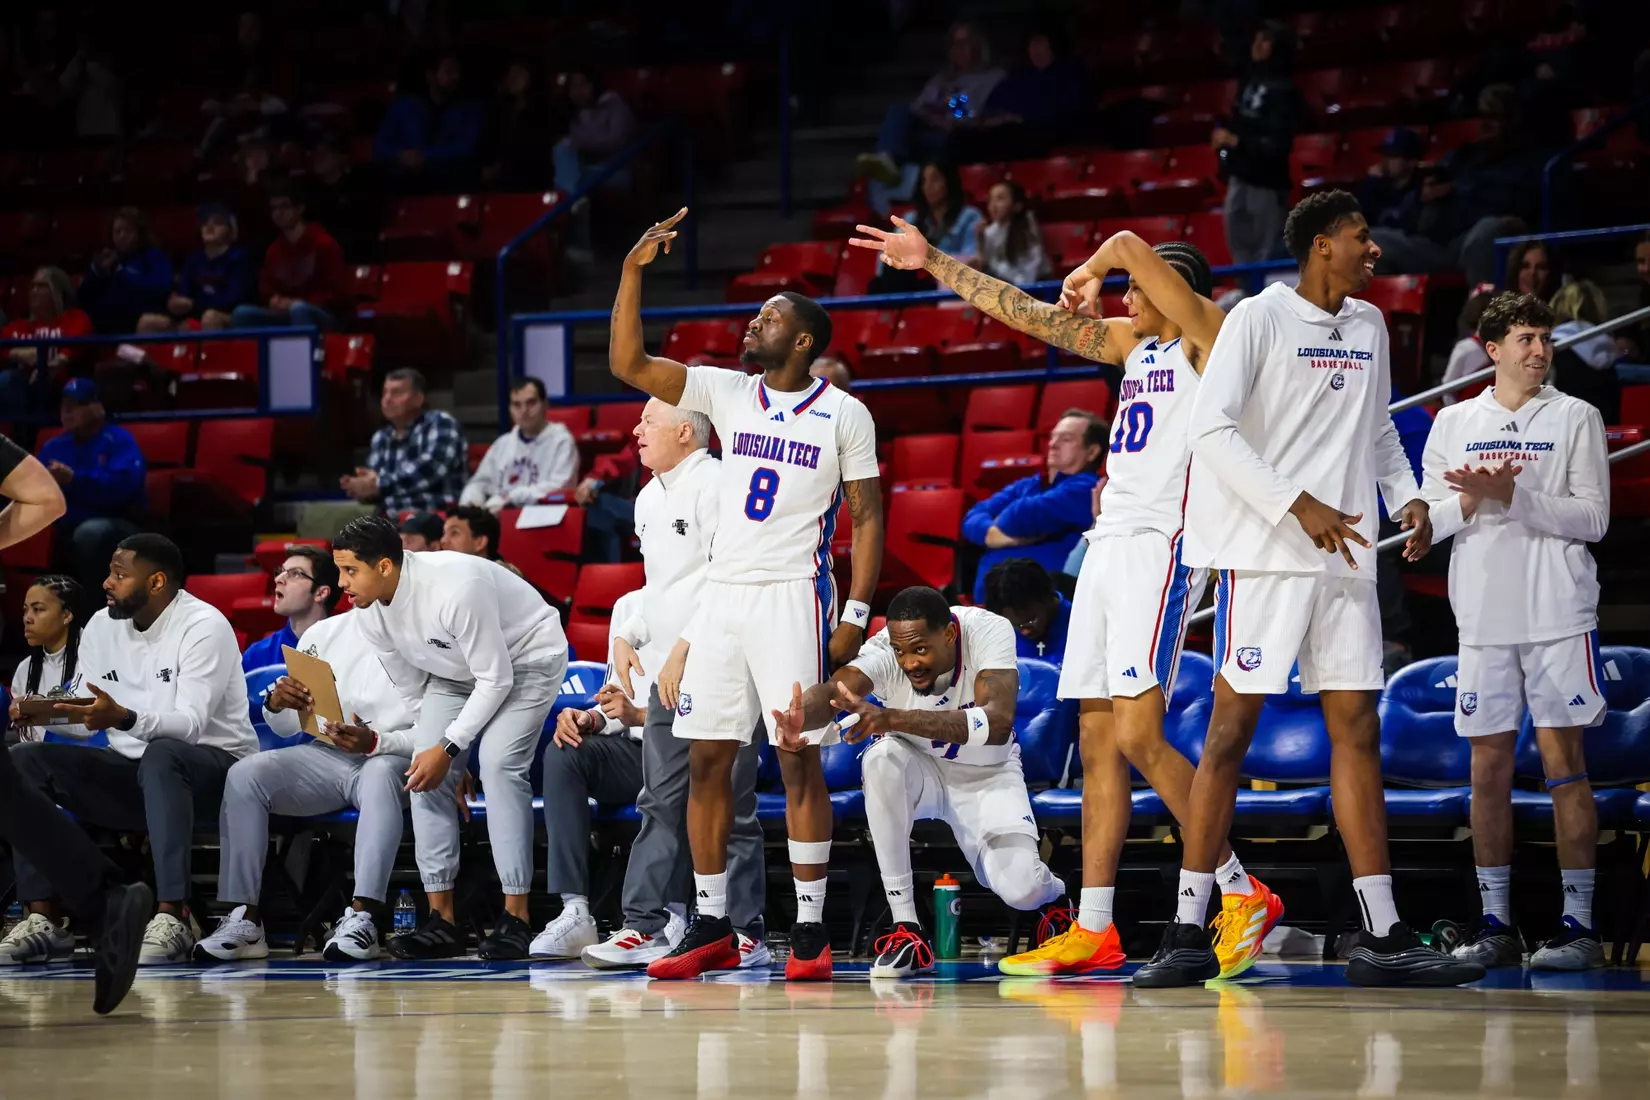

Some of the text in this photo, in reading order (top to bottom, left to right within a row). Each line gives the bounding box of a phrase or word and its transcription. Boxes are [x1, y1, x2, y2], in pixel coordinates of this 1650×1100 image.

[1297, 347, 1373, 361] LOUISIANA TECH
[1310, 360, 1364, 370] BASKETBALL
[1147, 369, 1174, 393] TECH
[1109, 401, 1154, 454] 10
[732, 431, 821, 470] LOUISIANA TECH
[1465, 440, 1554, 452] LOUISIANA TECH
[744, 466, 780, 522] 8
